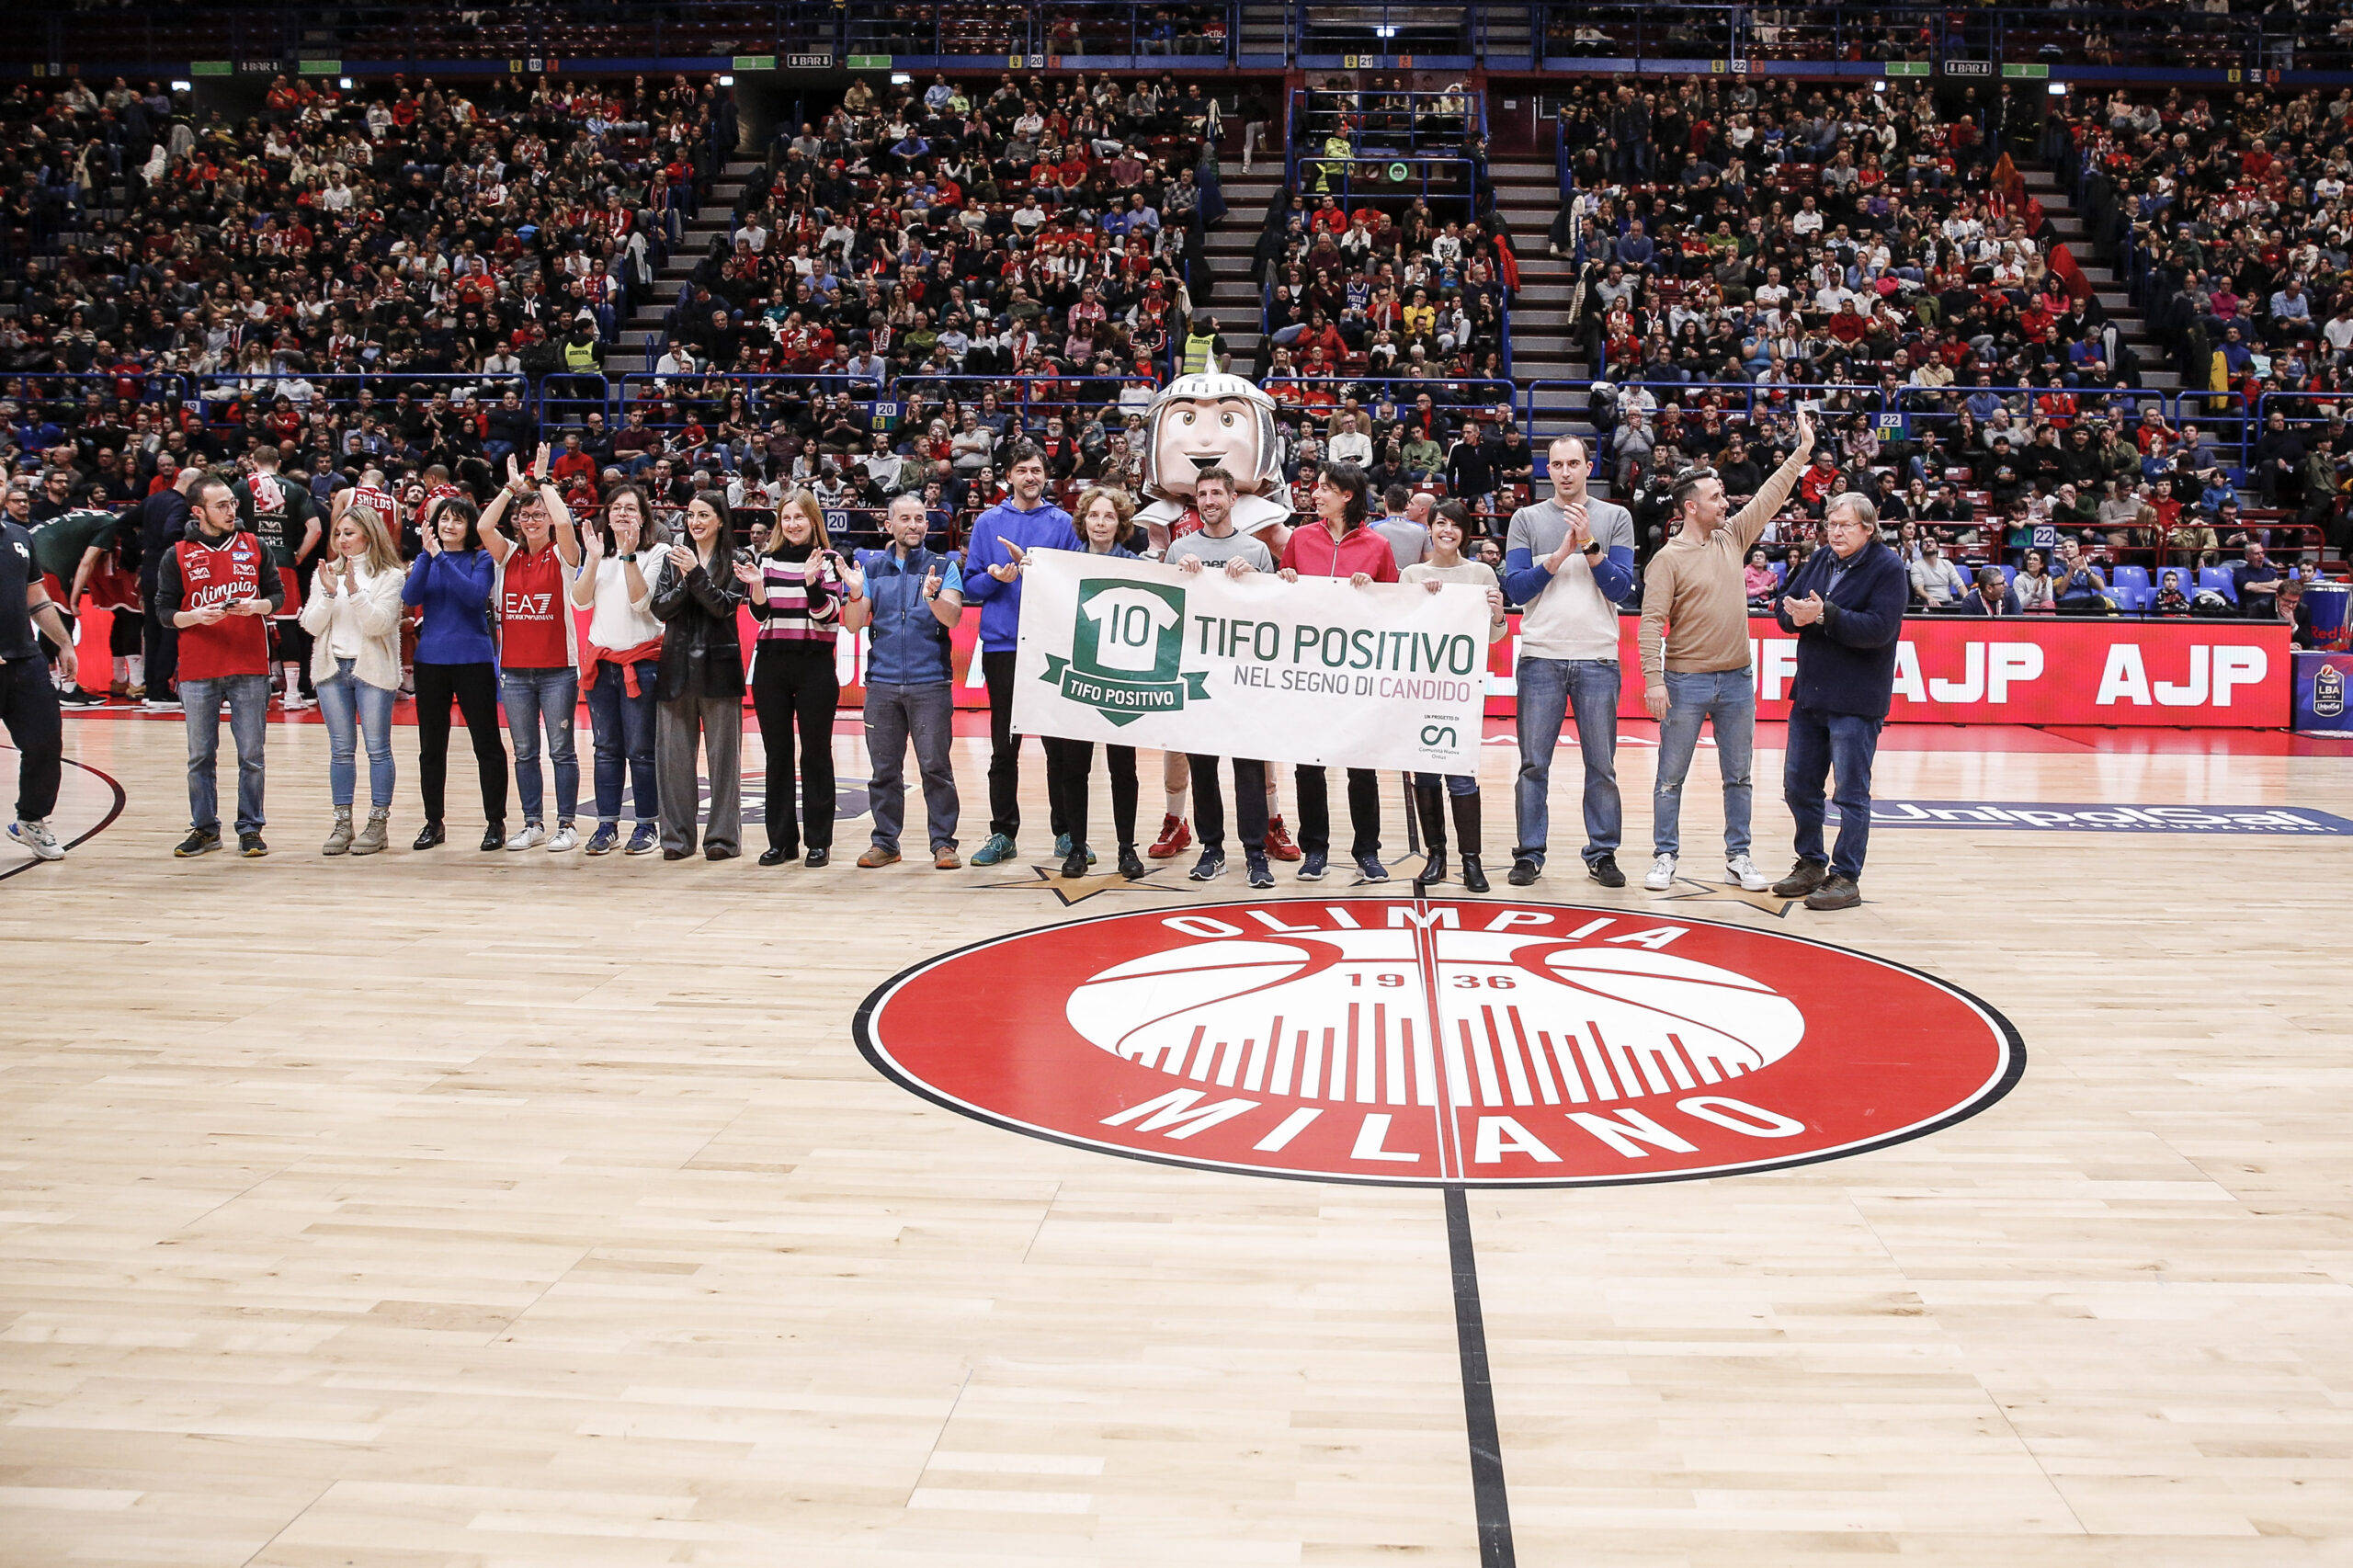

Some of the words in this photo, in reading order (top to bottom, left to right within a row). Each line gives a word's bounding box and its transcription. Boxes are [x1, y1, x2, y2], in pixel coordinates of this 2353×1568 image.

[530, 60, 540, 69] 19
[800, 56, 821, 66] BAR
[1031, 56, 1042, 65] 20
[1360, 57, 1371, 65] 21
[1733, 62, 1745, 71] 22
[1958, 64, 1980, 74] BAR
[879, 404, 893, 415] 20
[1883, 415, 1898, 426] 22
[828, 515, 846, 528] 20
[2014, 529, 2029, 542] A
[2035, 529, 2053, 543] 22
[233, 552, 250, 562] SAP
[191, 576, 257, 609] Olimpia
[506, 593, 552, 614] EA7
[1110, 603, 1151, 647] 10
[2311, 626, 2338, 640] Red
[1194, 615, 1280, 662] TIFO
[1293, 624, 1475, 676] POSITIVO
[1891, 640, 2044, 704] AJP
[2095, 643, 2268, 707] AJP
[1233, 665, 1276, 688] NEL
[1280, 669, 1349, 695] SEGNO
[1355, 676, 1373, 697] DI
[1380, 677, 1470, 702] CANDIDO
[2318, 686, 2340, 695] LBA
[1070, 679, 1102, 701] TIFO
[1105, 687, 1175, 707] POSITIVO
[1870, 803, 2322, 828] UnipolSai
[2068, 822, 2338, 832] ASSICURAZIONI
[1161, 903, 1690, 949] OLIMPIA
[1347, 971, 1406, 989] 19
[1453, 974, 1517, 990] 36
[1098, 1088, 1807, 1164] MILANO
